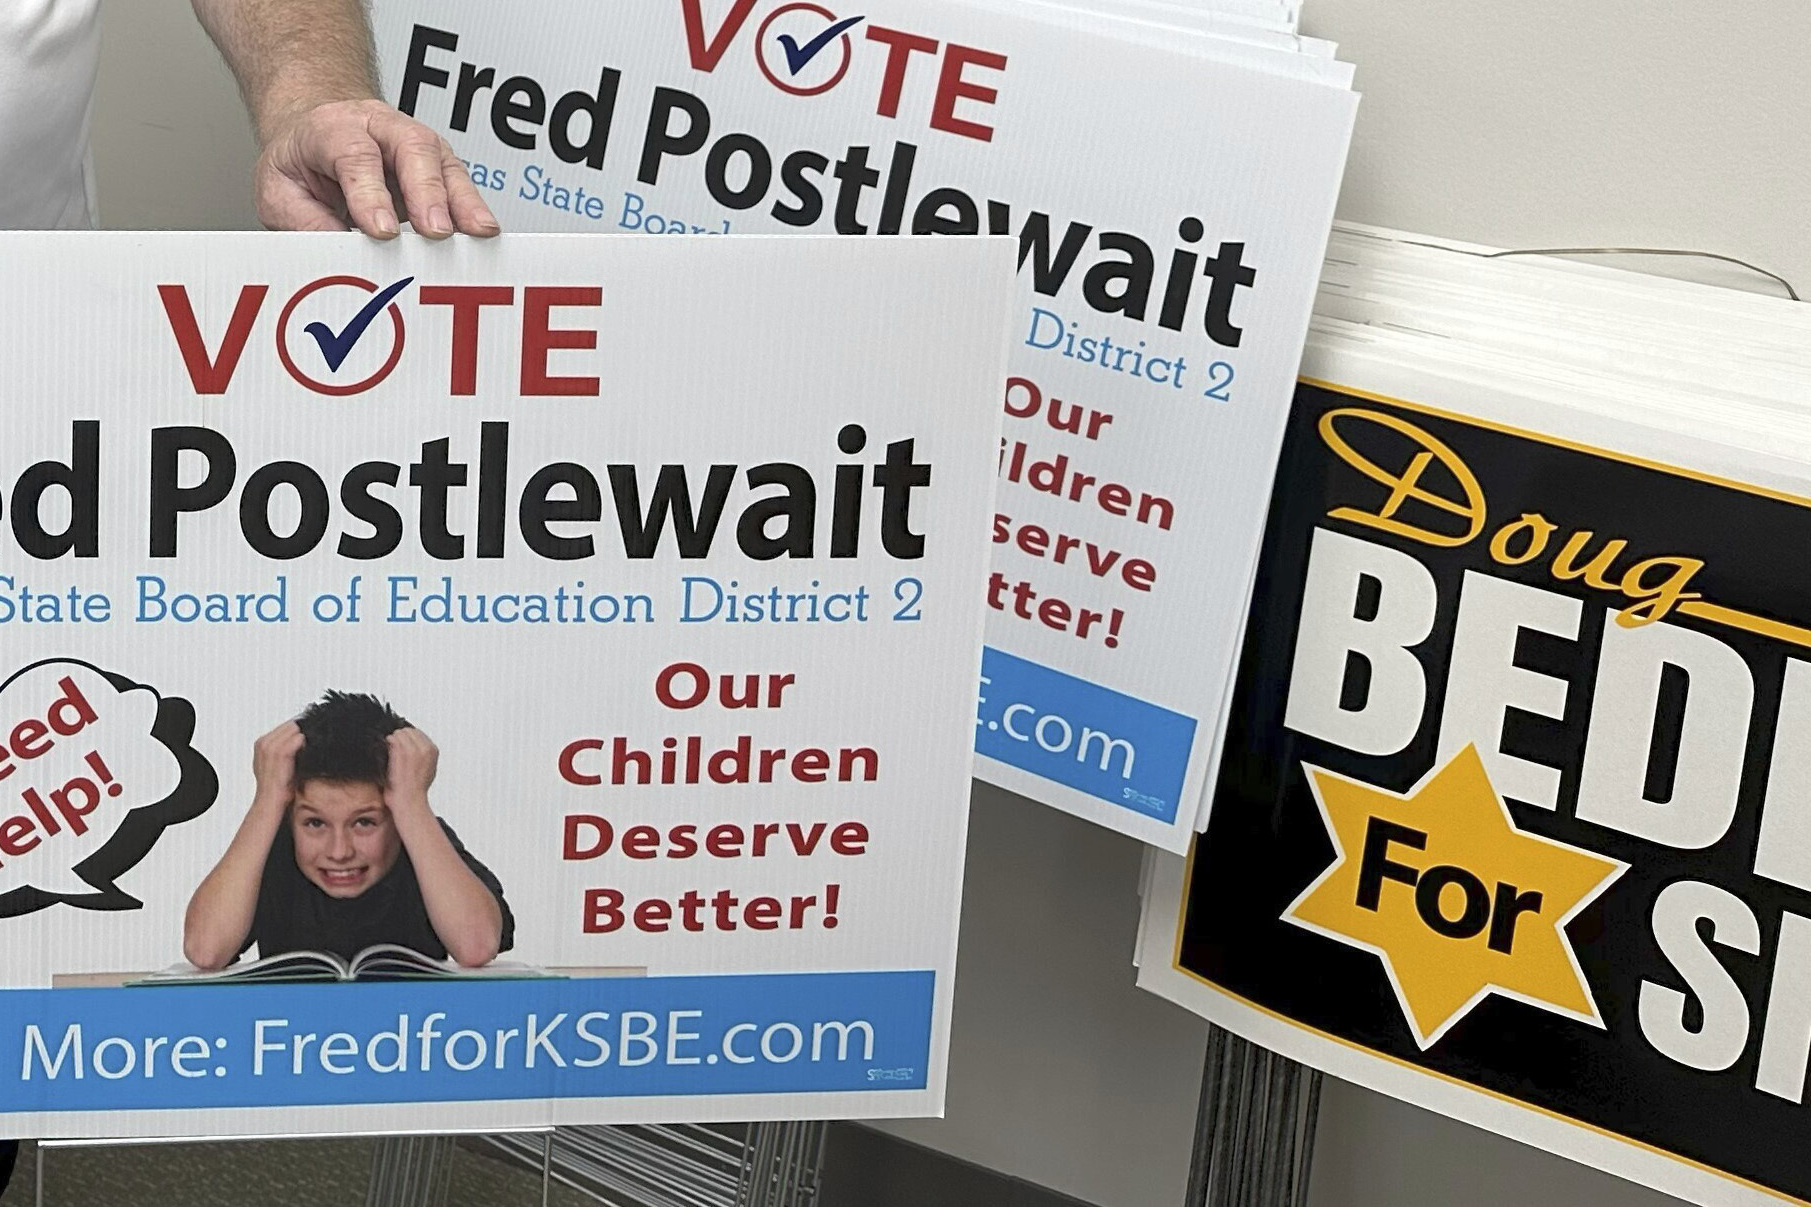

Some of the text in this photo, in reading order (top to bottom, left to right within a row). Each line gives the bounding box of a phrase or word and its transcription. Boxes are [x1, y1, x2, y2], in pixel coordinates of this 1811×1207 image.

[398, 22, 1256, 348] Fred Postlewait
[519, 164, 605, 220] State
[157, 275, 603, 397] VOTE
[1025, 307, 1236, 403] District 2
[1003, 376, 1114, 441] Our
[150, 421, 932, 561] Postlewait
[1317, 406, 1707, 629] Doug
[136, 576, 289, 624] Board
[312, 575, 362, 623] of
[386, 576, 654, 624] Education
[680, 577, 870, 624] District
[893, 577, 922, 622] 2
[655, 662, 796, 710] Our
[557, 736, 879, 786] Children
[563, 814, 870, 862] Deserve
[582, 884, 842, 934] Better!
[1355, 814, 1542, 956] For
[21, 1023, 228, 1082] More:
[252, 1010, 876, 1077] FredforKSBE.com
